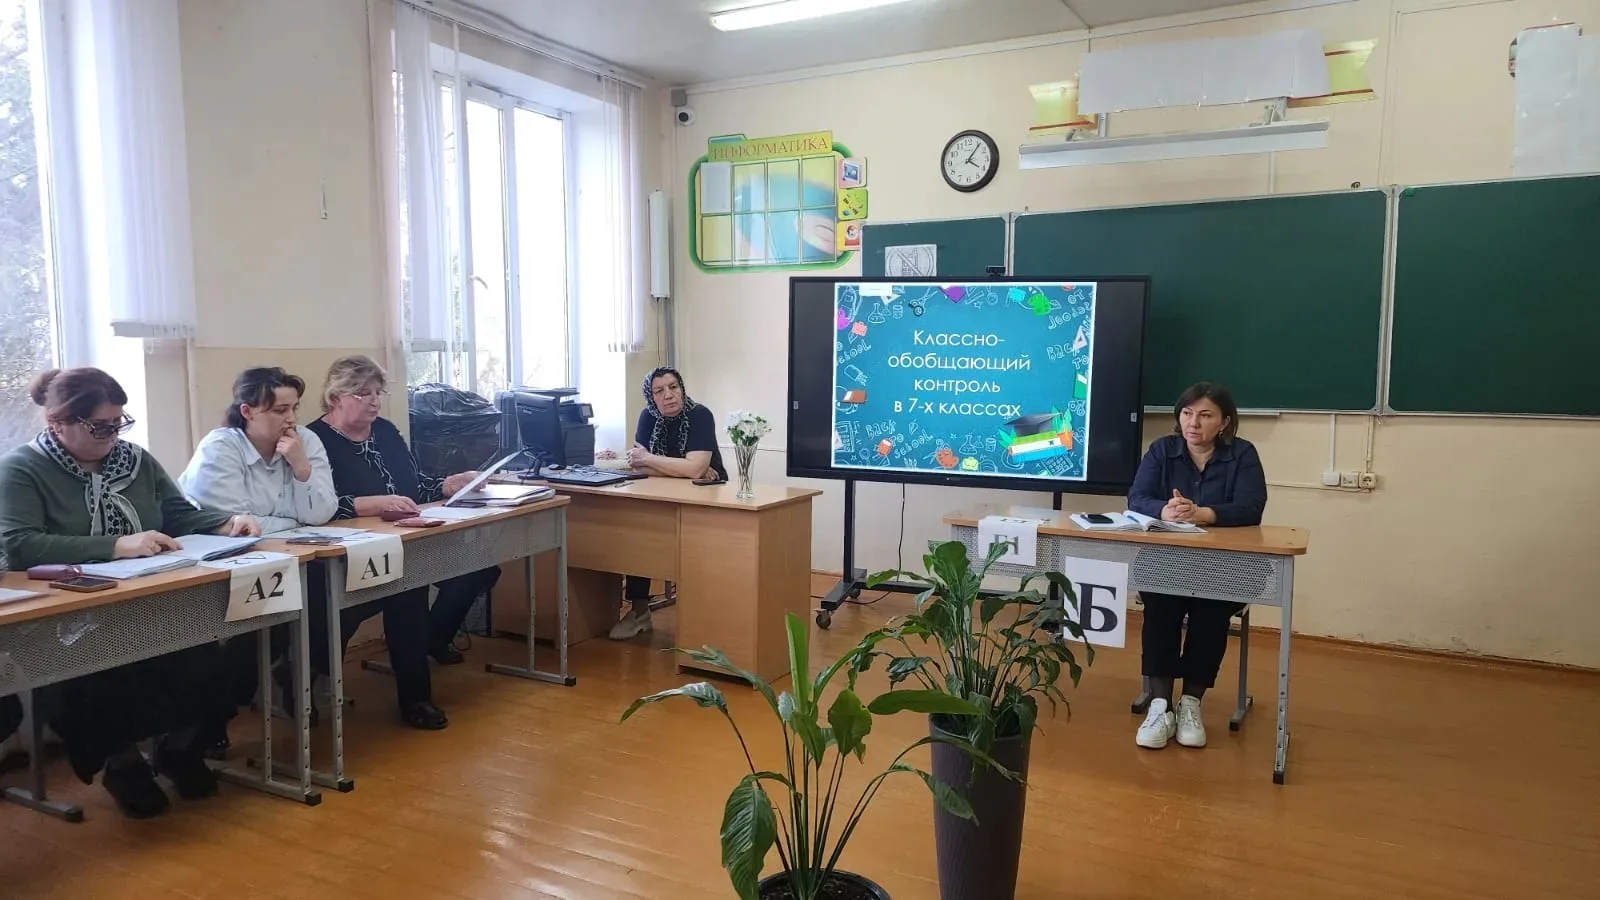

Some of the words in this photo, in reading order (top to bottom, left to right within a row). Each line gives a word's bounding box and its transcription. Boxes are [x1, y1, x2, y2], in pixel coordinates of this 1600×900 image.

[713, 137, 828, 160] ИНФОРМАТИКА
[964, 138, 973, 146] 12
[914, 330, 1006, 346] Классно-
[888, 353, 1031, 371] обобщающий
[914, 379, 1001, 395] контроль
[894, 400, 903, 413] в
[908, 398, 934, 414] 7-х
[939, 402, 1021, 416] классах
[1074, 581, 1118, 633] Б
